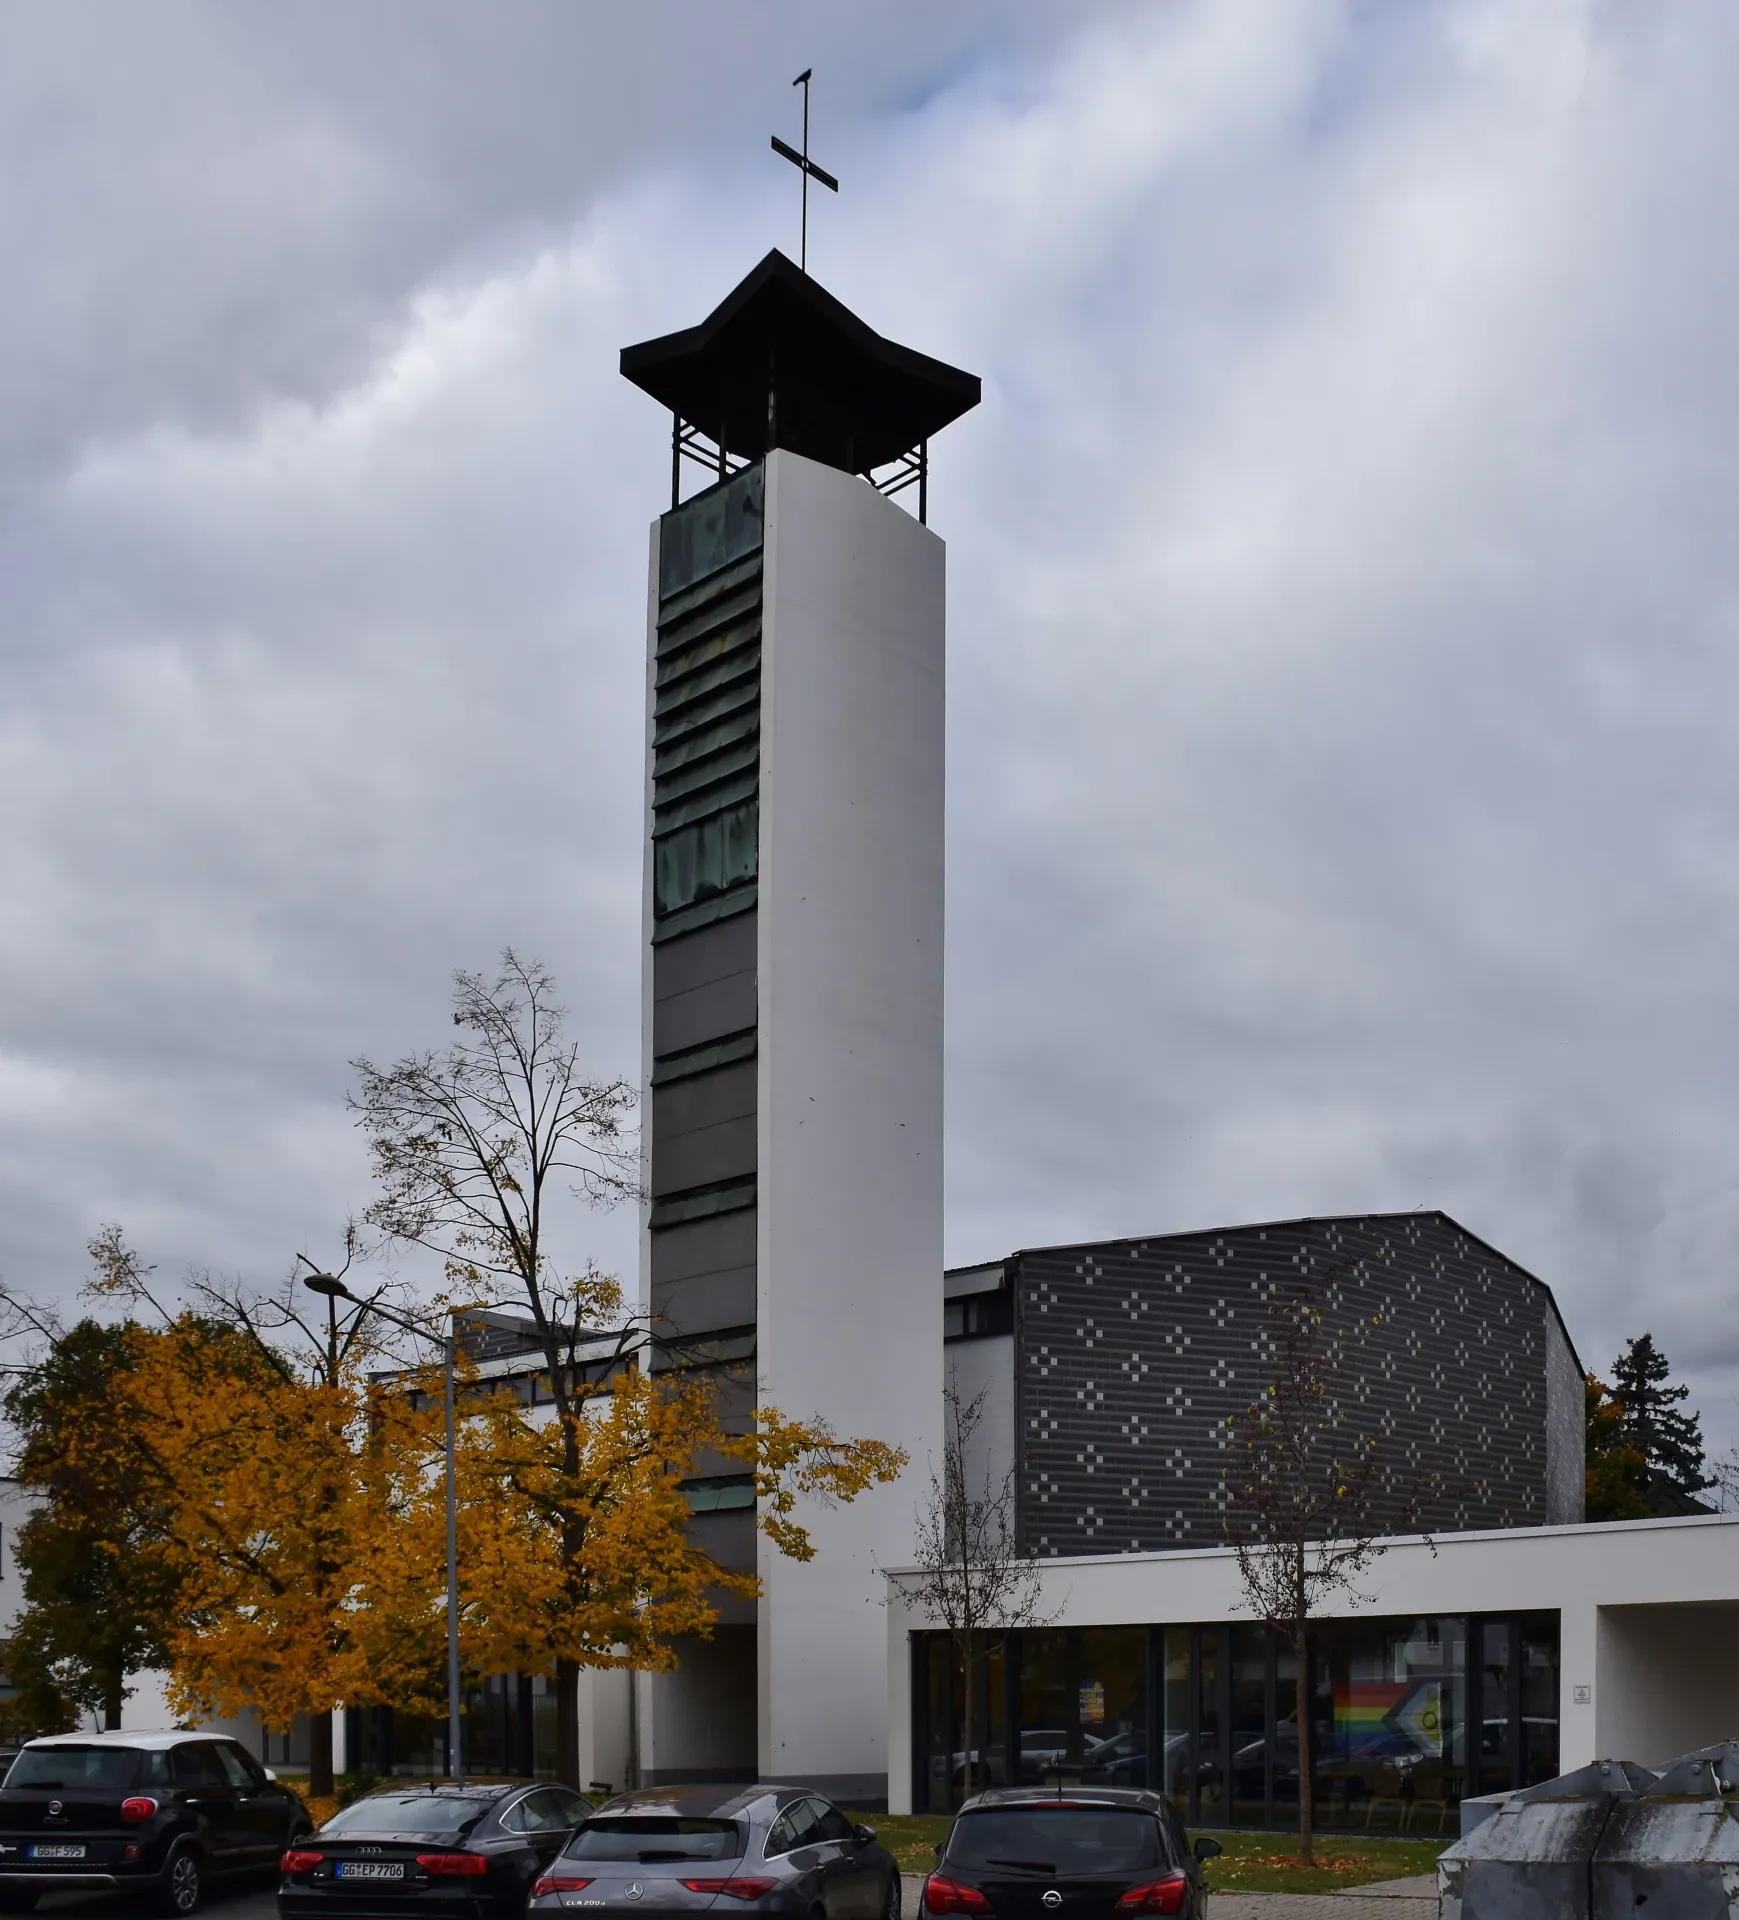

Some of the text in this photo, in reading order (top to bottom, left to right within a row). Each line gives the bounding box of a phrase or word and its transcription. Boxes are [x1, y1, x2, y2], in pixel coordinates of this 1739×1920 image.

[37, 1846, 50, 1856] GG
[63, 1846, 82, 1856] 595
[342, 1864, 402, 1876] GG EP 7706
